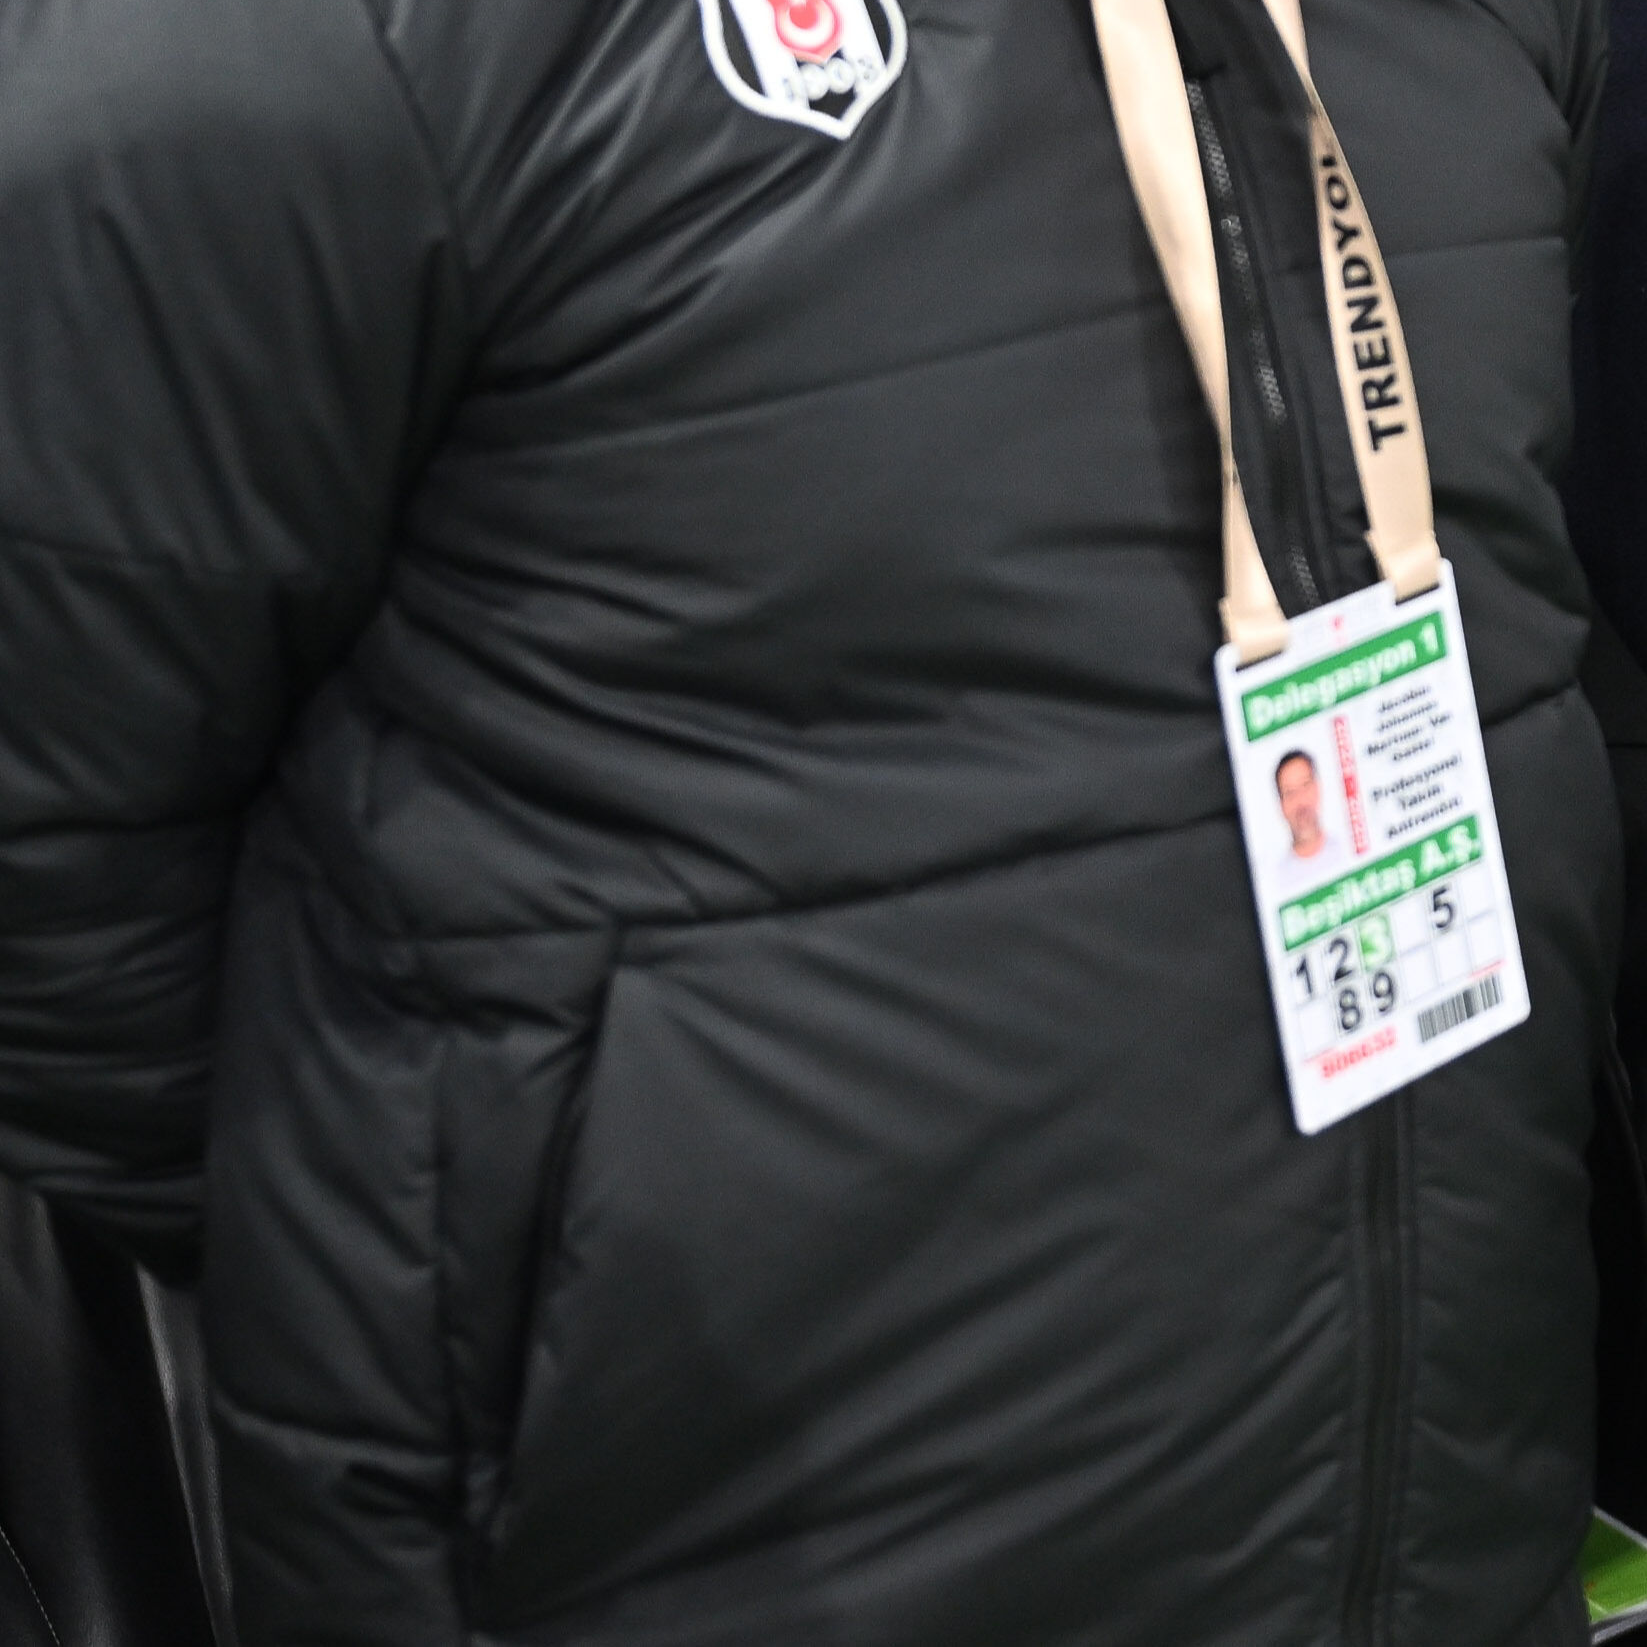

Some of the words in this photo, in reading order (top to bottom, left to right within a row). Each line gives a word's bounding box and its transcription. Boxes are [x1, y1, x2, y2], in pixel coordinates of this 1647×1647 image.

[1250, 638, 1417, 730] Delegasyon
[1419, 621, 1439, 654] 1
[1281, 858, 1416, 943] Beşiktaş
[1418, 824, 1481, 877] A.Ş.
[1295, 956, 1313, 995] 1
[1328, 937, 1353, 982] 2
[1431, 885, 1455, 929] 5
[1338, 988, 1361, 1031] 8
[1373, 971, 1395, 1013] 9
